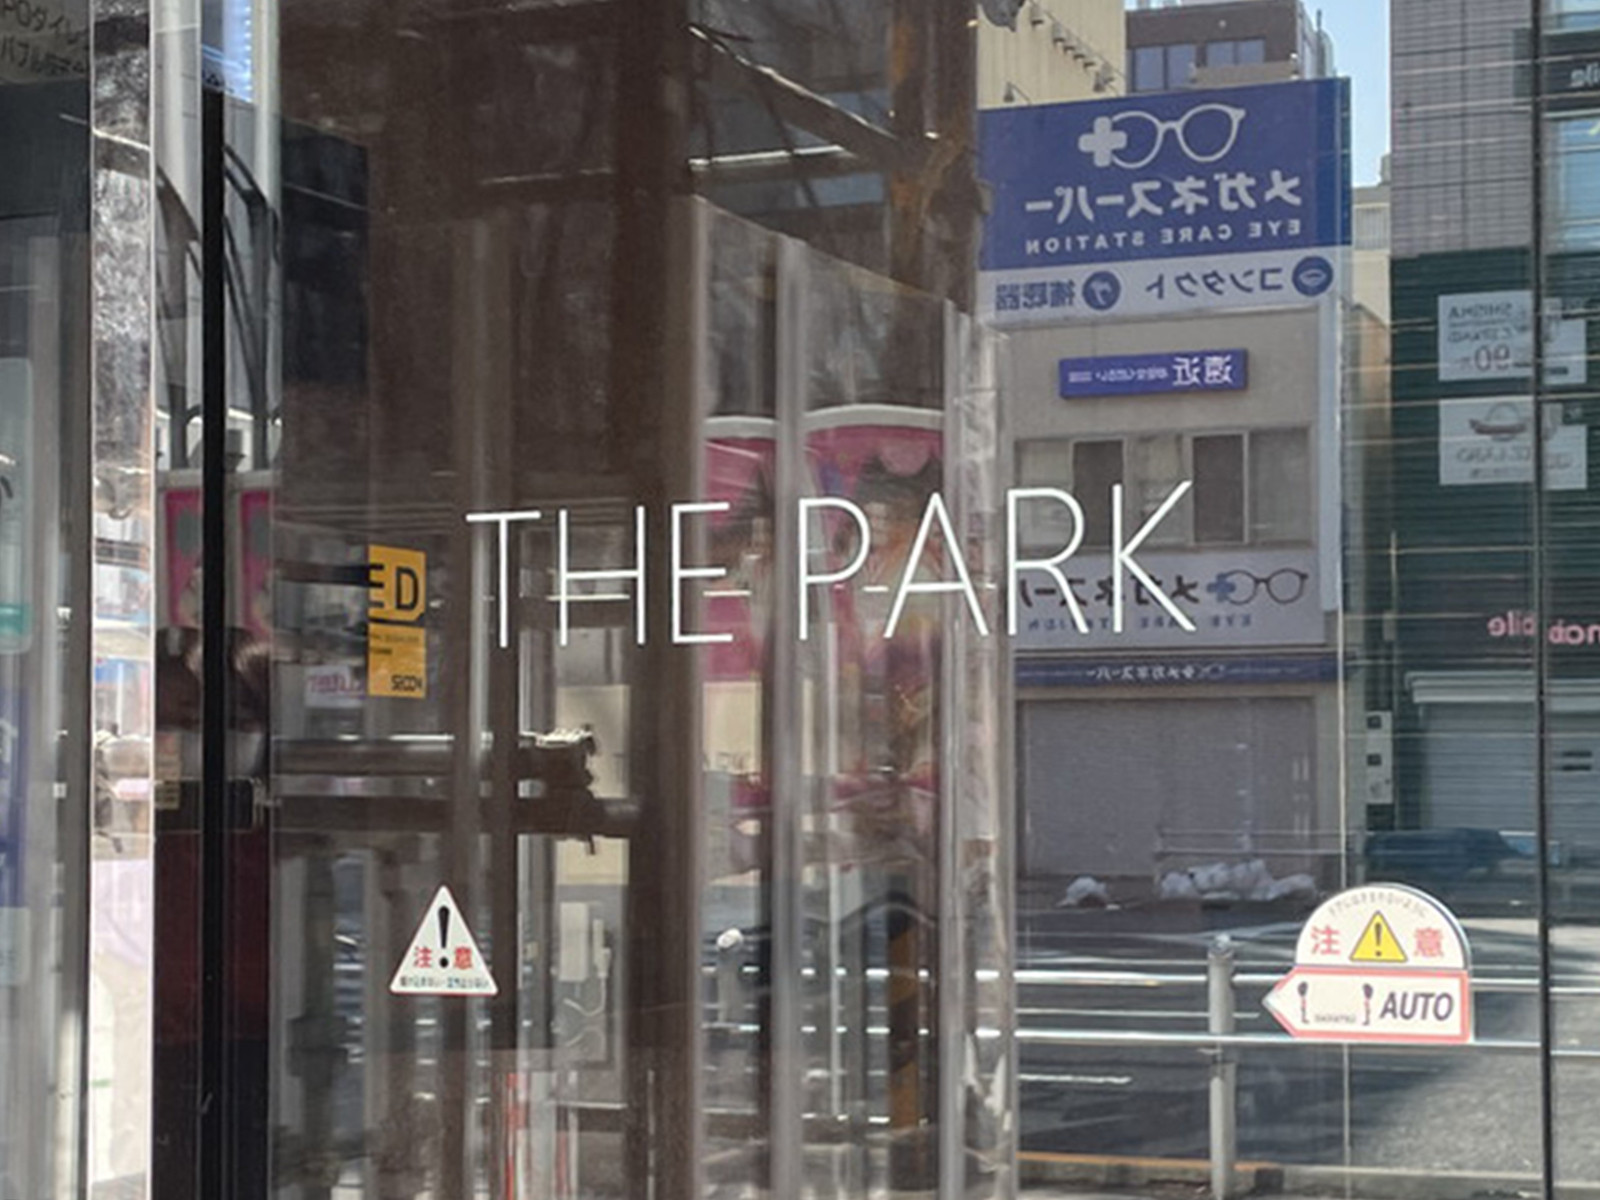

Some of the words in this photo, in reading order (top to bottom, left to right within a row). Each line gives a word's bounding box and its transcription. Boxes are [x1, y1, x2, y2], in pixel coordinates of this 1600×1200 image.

[465, 502, 733, 648] THE
[799, 480, 1196, 639] PARK
[1378, 990, 1455, 1022] AUTO
